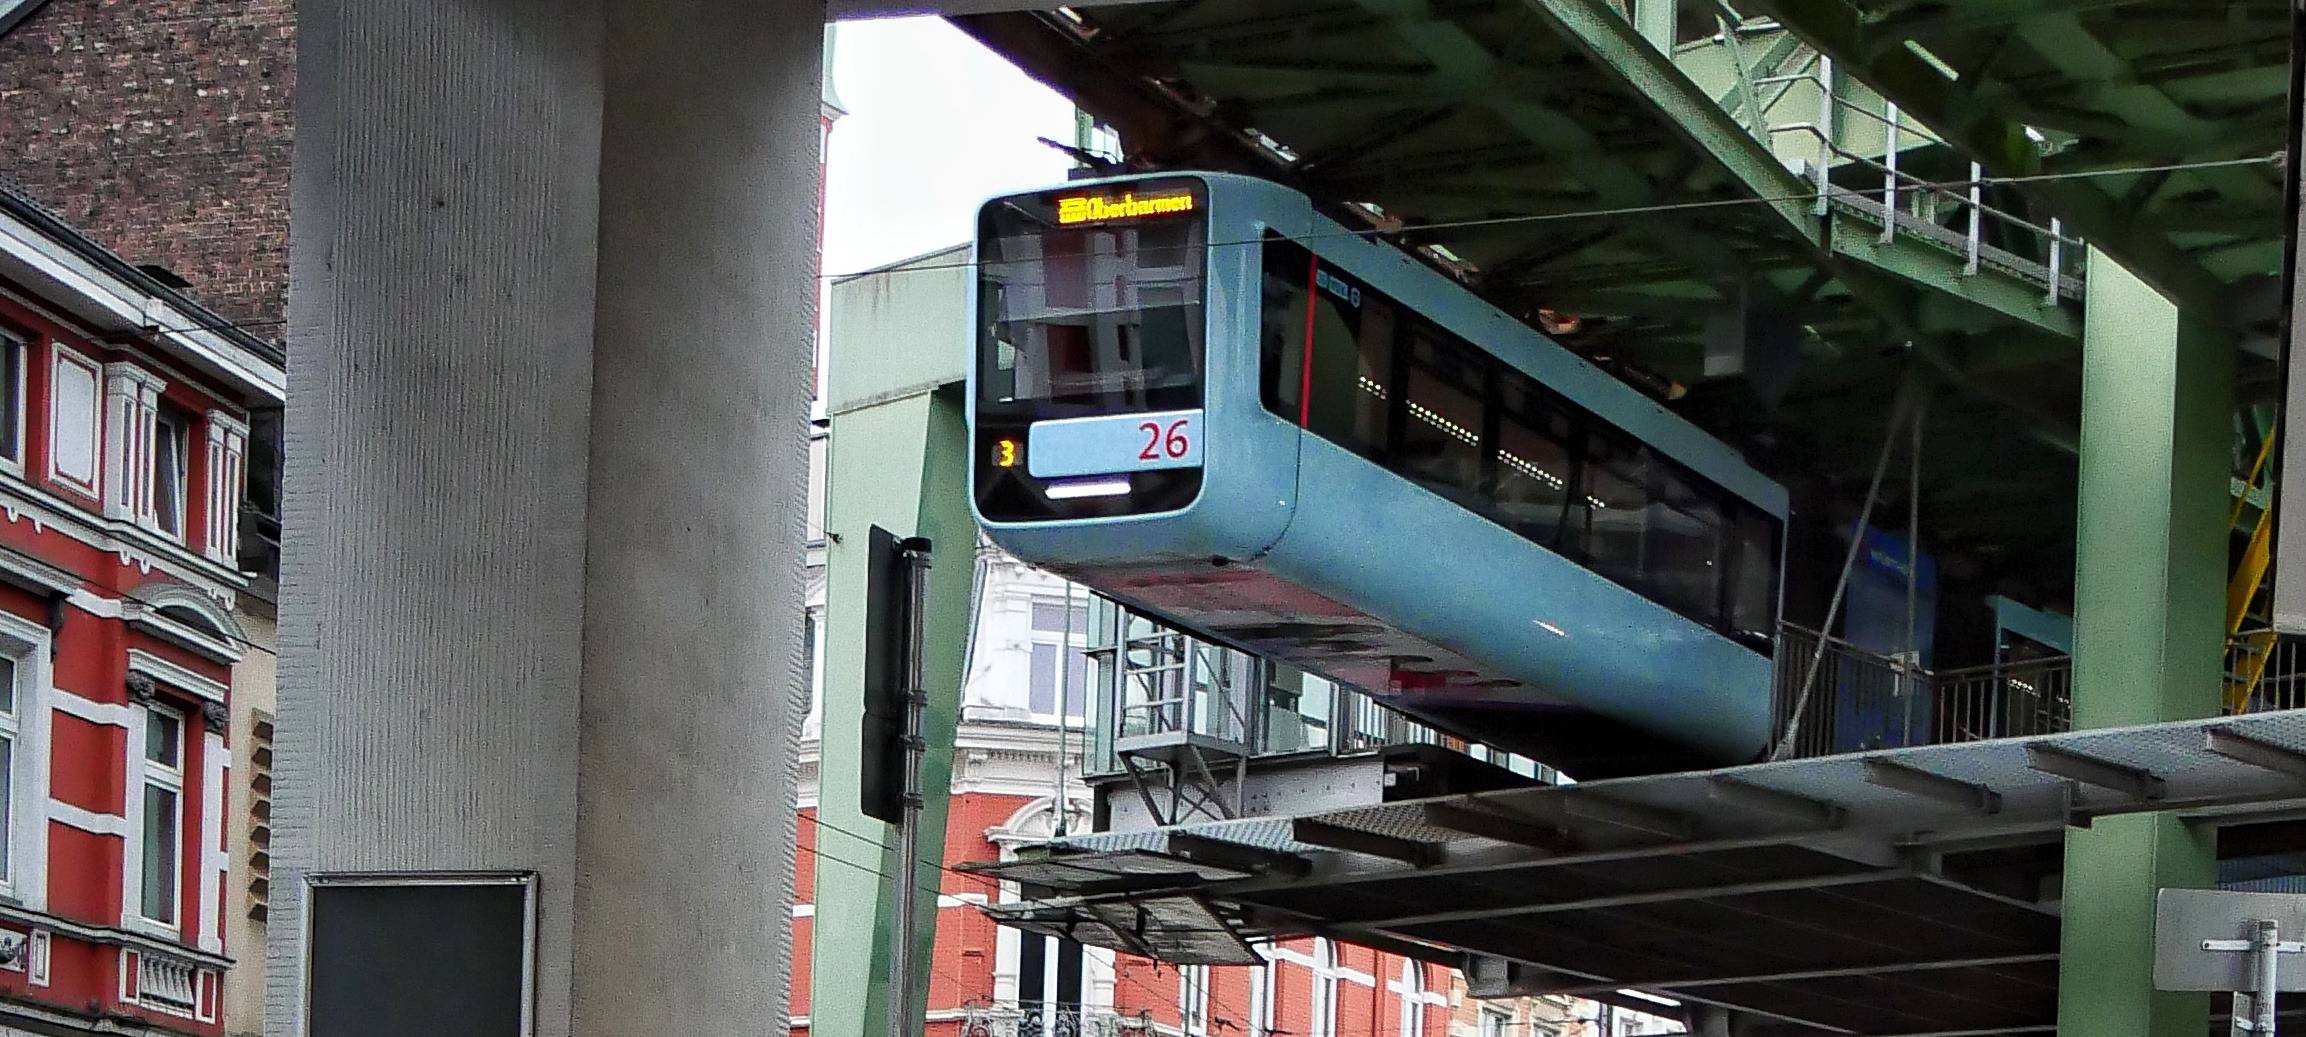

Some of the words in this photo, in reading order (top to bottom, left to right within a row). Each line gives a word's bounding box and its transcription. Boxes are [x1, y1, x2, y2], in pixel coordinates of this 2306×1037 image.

[1087, 193, 1192, 219] Oberbarmen
[999, 440, 1014, 467] 3
[1138, 420, 1188, 460] 26
